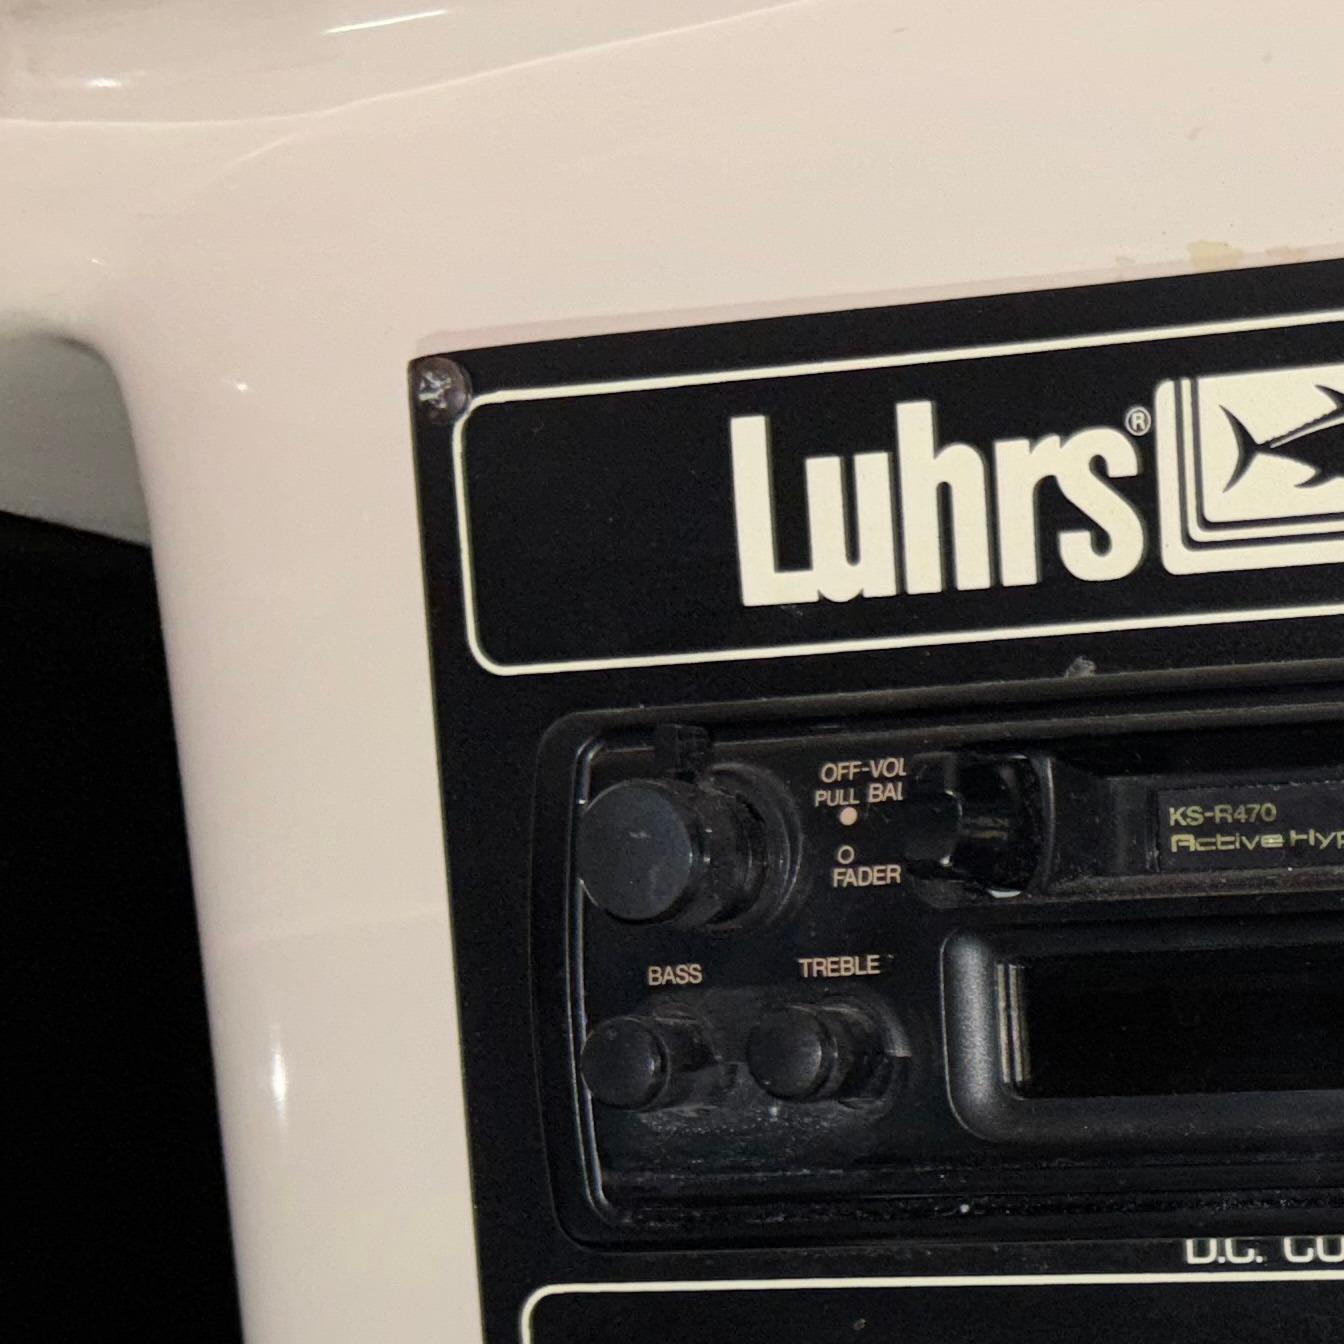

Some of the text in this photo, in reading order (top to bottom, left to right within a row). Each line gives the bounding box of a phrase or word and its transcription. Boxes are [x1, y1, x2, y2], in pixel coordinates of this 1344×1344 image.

[821, 757, 907, 783] OFF-VOL
[814, 788, 860, 807] PULL
[1169, 802, 1277, 826] KS-R470
[1171, 832, 1284, 852] Active
[832, 864, 902, 888] FADER
[648, 965, 702, 986] BASS
[800, 955, 880, 978] TREBLE
